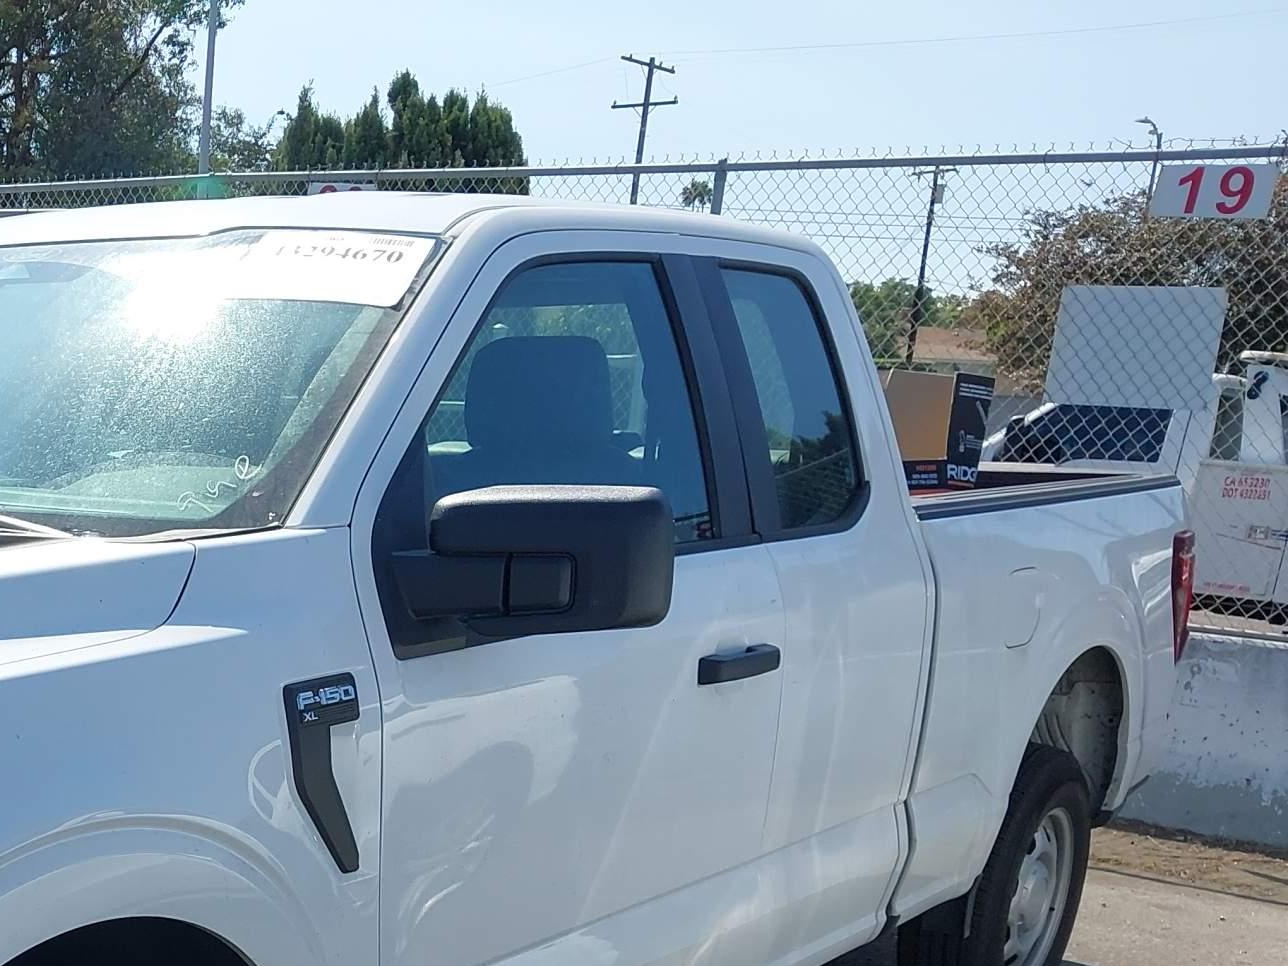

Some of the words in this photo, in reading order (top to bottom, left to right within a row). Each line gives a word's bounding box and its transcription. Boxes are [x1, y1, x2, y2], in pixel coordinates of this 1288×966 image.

[1177, 165, 1256, 215] 19
[297, 685, 355, 710] F-150
[303, 711, 319, 721] XL
